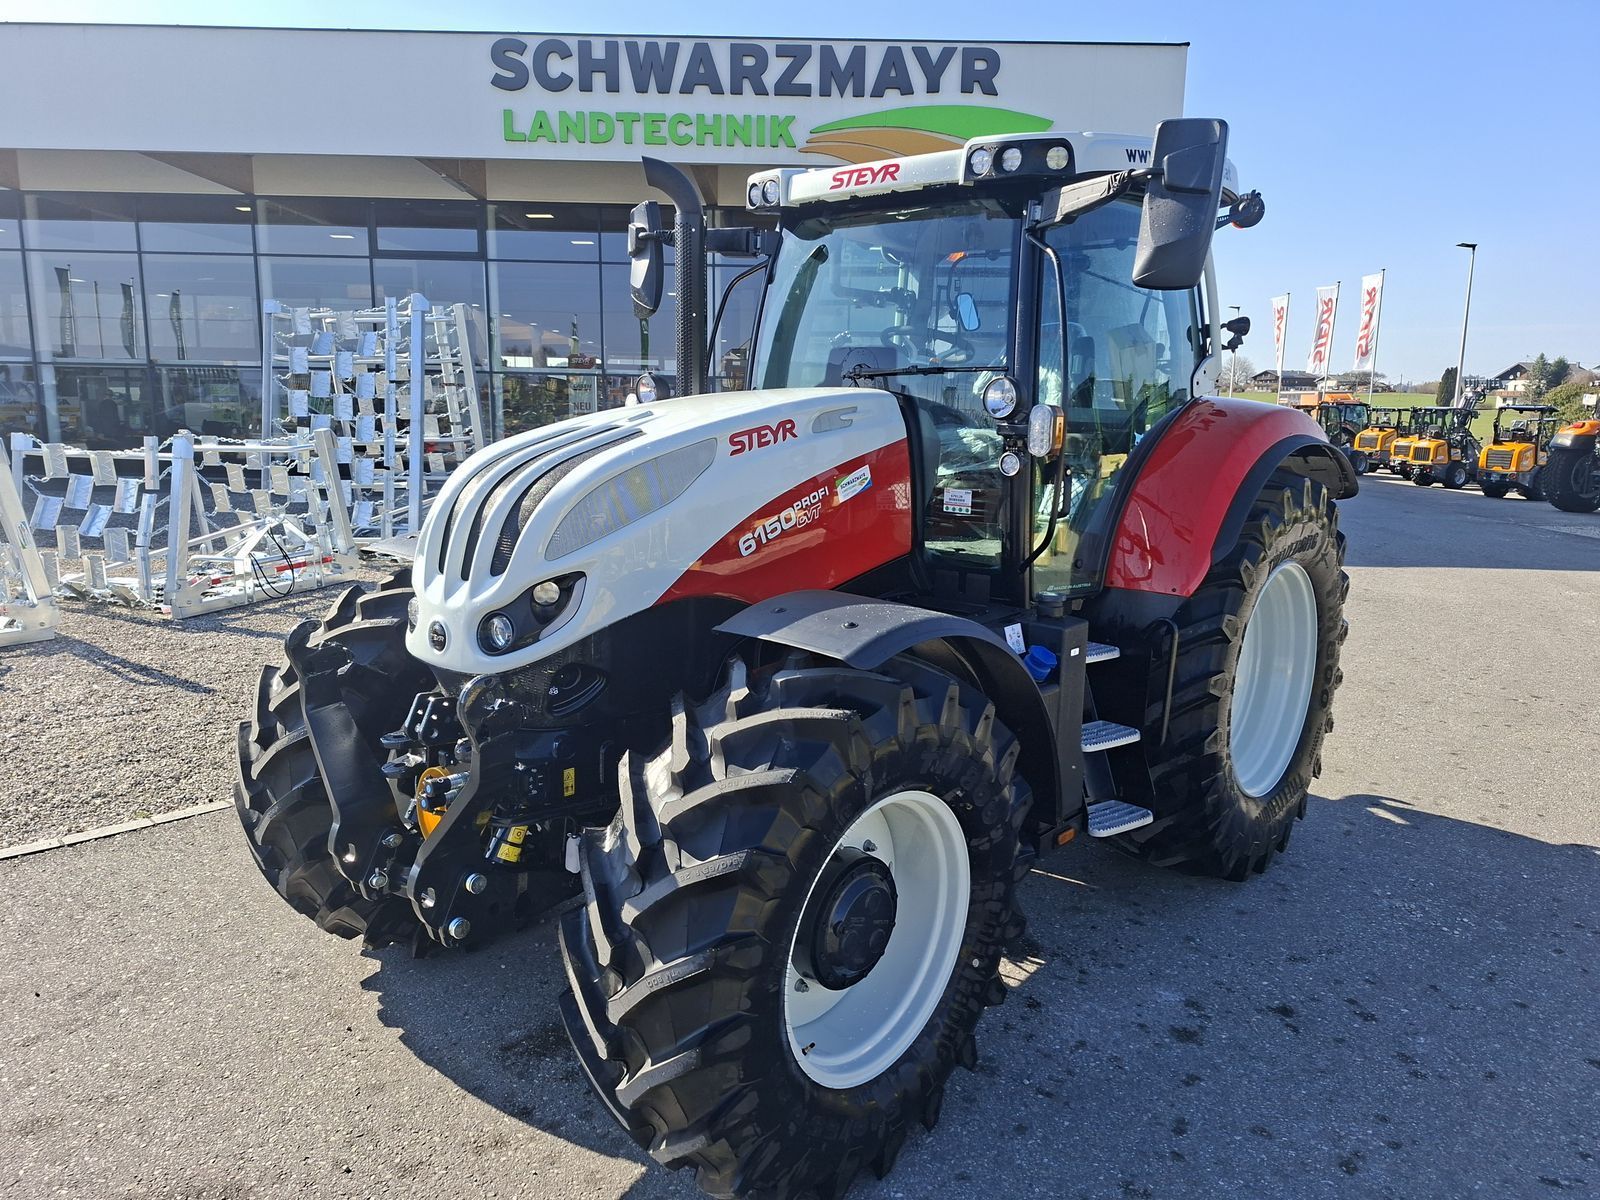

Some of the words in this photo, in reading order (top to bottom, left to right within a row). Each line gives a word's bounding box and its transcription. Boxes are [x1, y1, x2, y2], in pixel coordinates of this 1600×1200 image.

[490, 38, 1001, 98] SCHWARZMAYR
[503, 109, 797, 148] LANDTECHNIK
[1125, 148, 1152, 164] WW
[829, 163, 901, 190] STEYR
[573, 401, 592, 411] NEU
[729, 418, 798, 456] STEYR
[738, 506, 797, 557] 6150
[793, 486, 830, 512] PROFI
